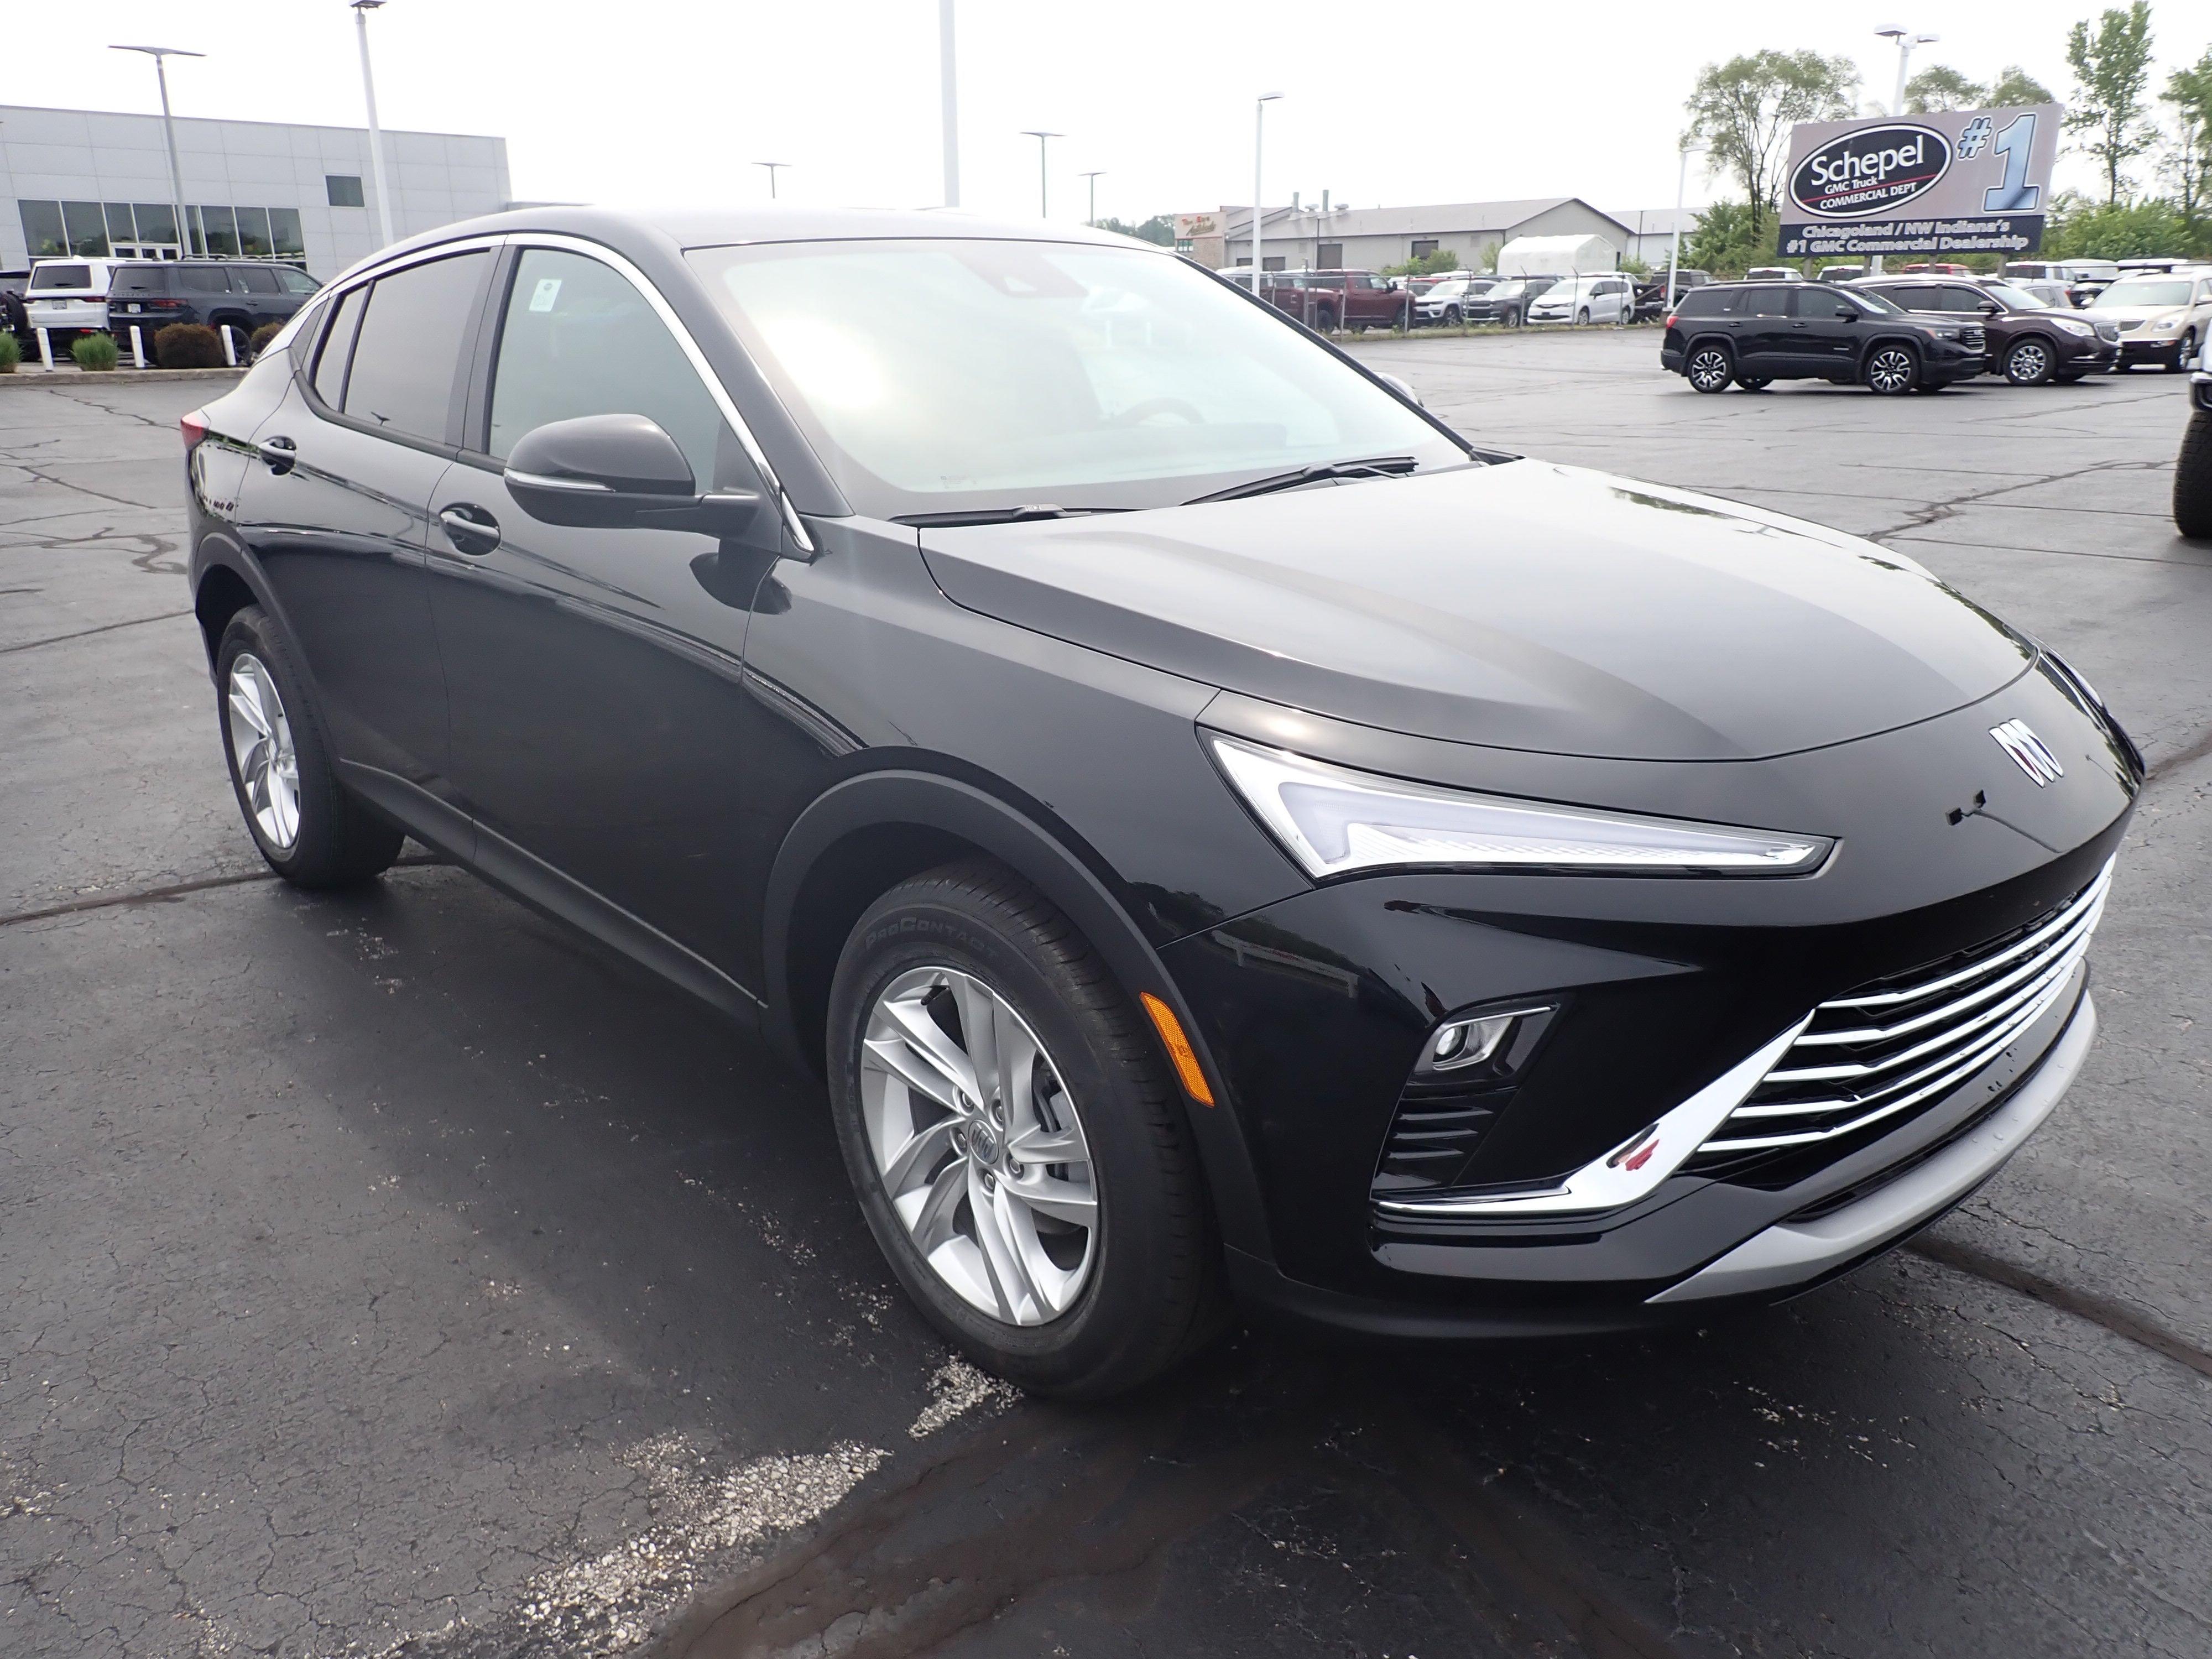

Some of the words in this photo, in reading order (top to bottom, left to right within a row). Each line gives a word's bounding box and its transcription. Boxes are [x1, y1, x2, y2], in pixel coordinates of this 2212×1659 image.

[1811, 134, 1924, 186] Schepel
[1824, 181, 1850, 194] GMC
[1851, 176, 1878, 189] Truck
[1820, 187, 1888, 210] COMMERCIAL
[1890, 182, 1917, 196] DEPT
[1802, 222, 1894, 239] Chicagoland
[1904, 222, 1934, 235] NW
[1786, 239, 1807, 253] #1
[1809, 241, 1846, 252] GMC
[1846, 237, 1938, 252] Commercial
[1939, 234, 2029, 251] Dealership
